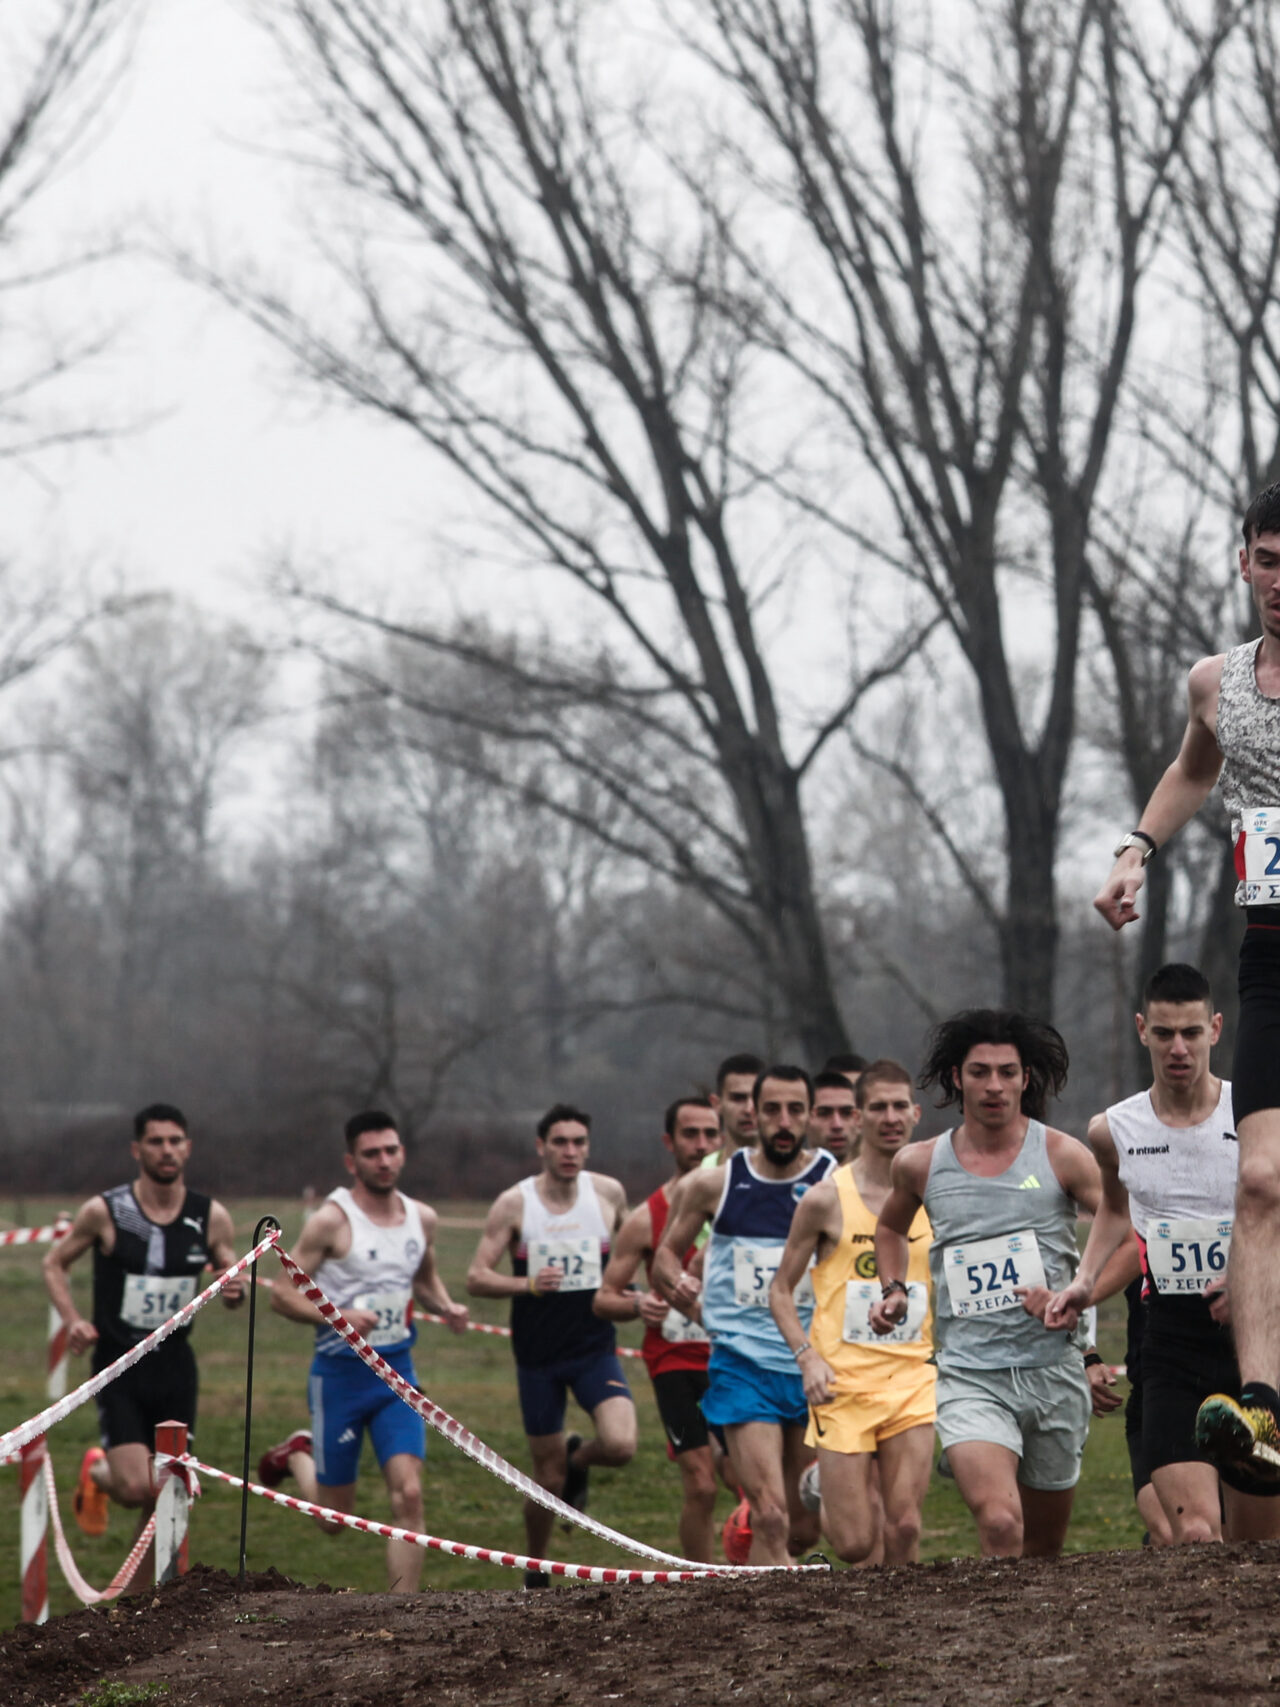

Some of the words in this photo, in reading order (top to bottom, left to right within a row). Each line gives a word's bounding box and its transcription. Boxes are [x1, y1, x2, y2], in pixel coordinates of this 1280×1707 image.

[1136, 1144, 1170, 1156] intrakat
[1171, 1241, 1226, 1273] 516
[967, 1257, 1020, 1295] 524
[1176, 1277, 1213, 1291] ΣΕΓΑ
[142, 1293, 180, 1314] 514
[975, 1292, 1023, 1312] ΣΕΓΑΣ
